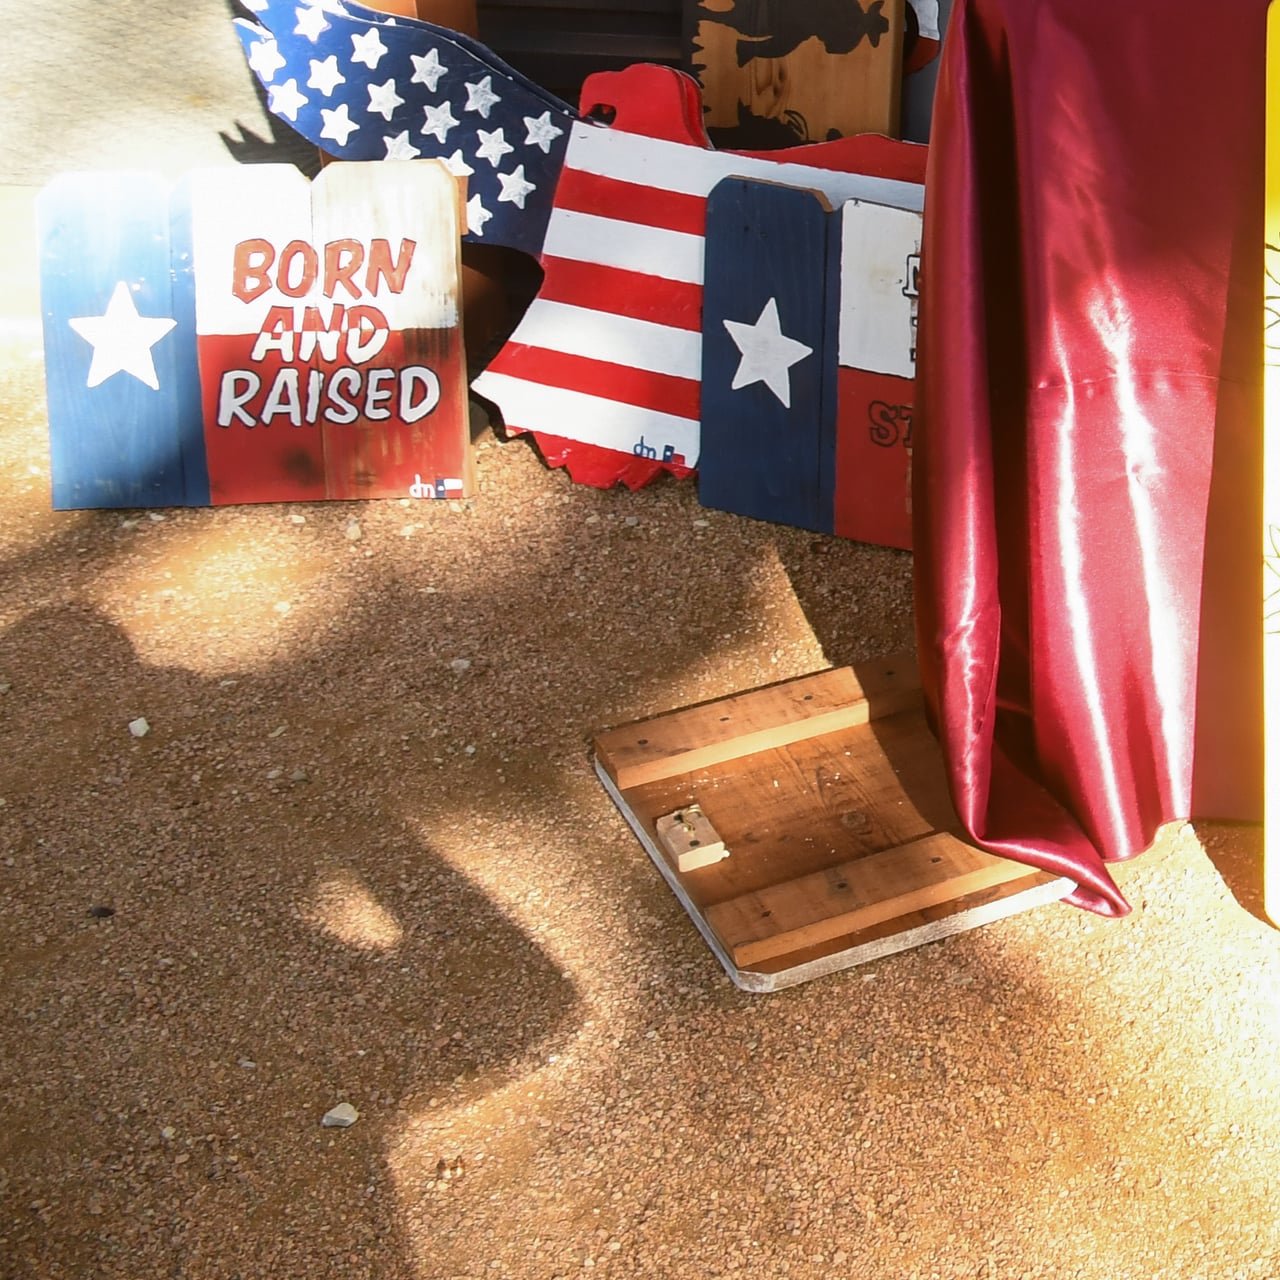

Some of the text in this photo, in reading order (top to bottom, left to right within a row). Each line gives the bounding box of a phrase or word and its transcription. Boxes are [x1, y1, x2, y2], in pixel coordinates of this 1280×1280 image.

[232, 237, 417, 304] BORN
[251, 303, 390, 365] AND
[216, 366, 441, 428] RAISED
